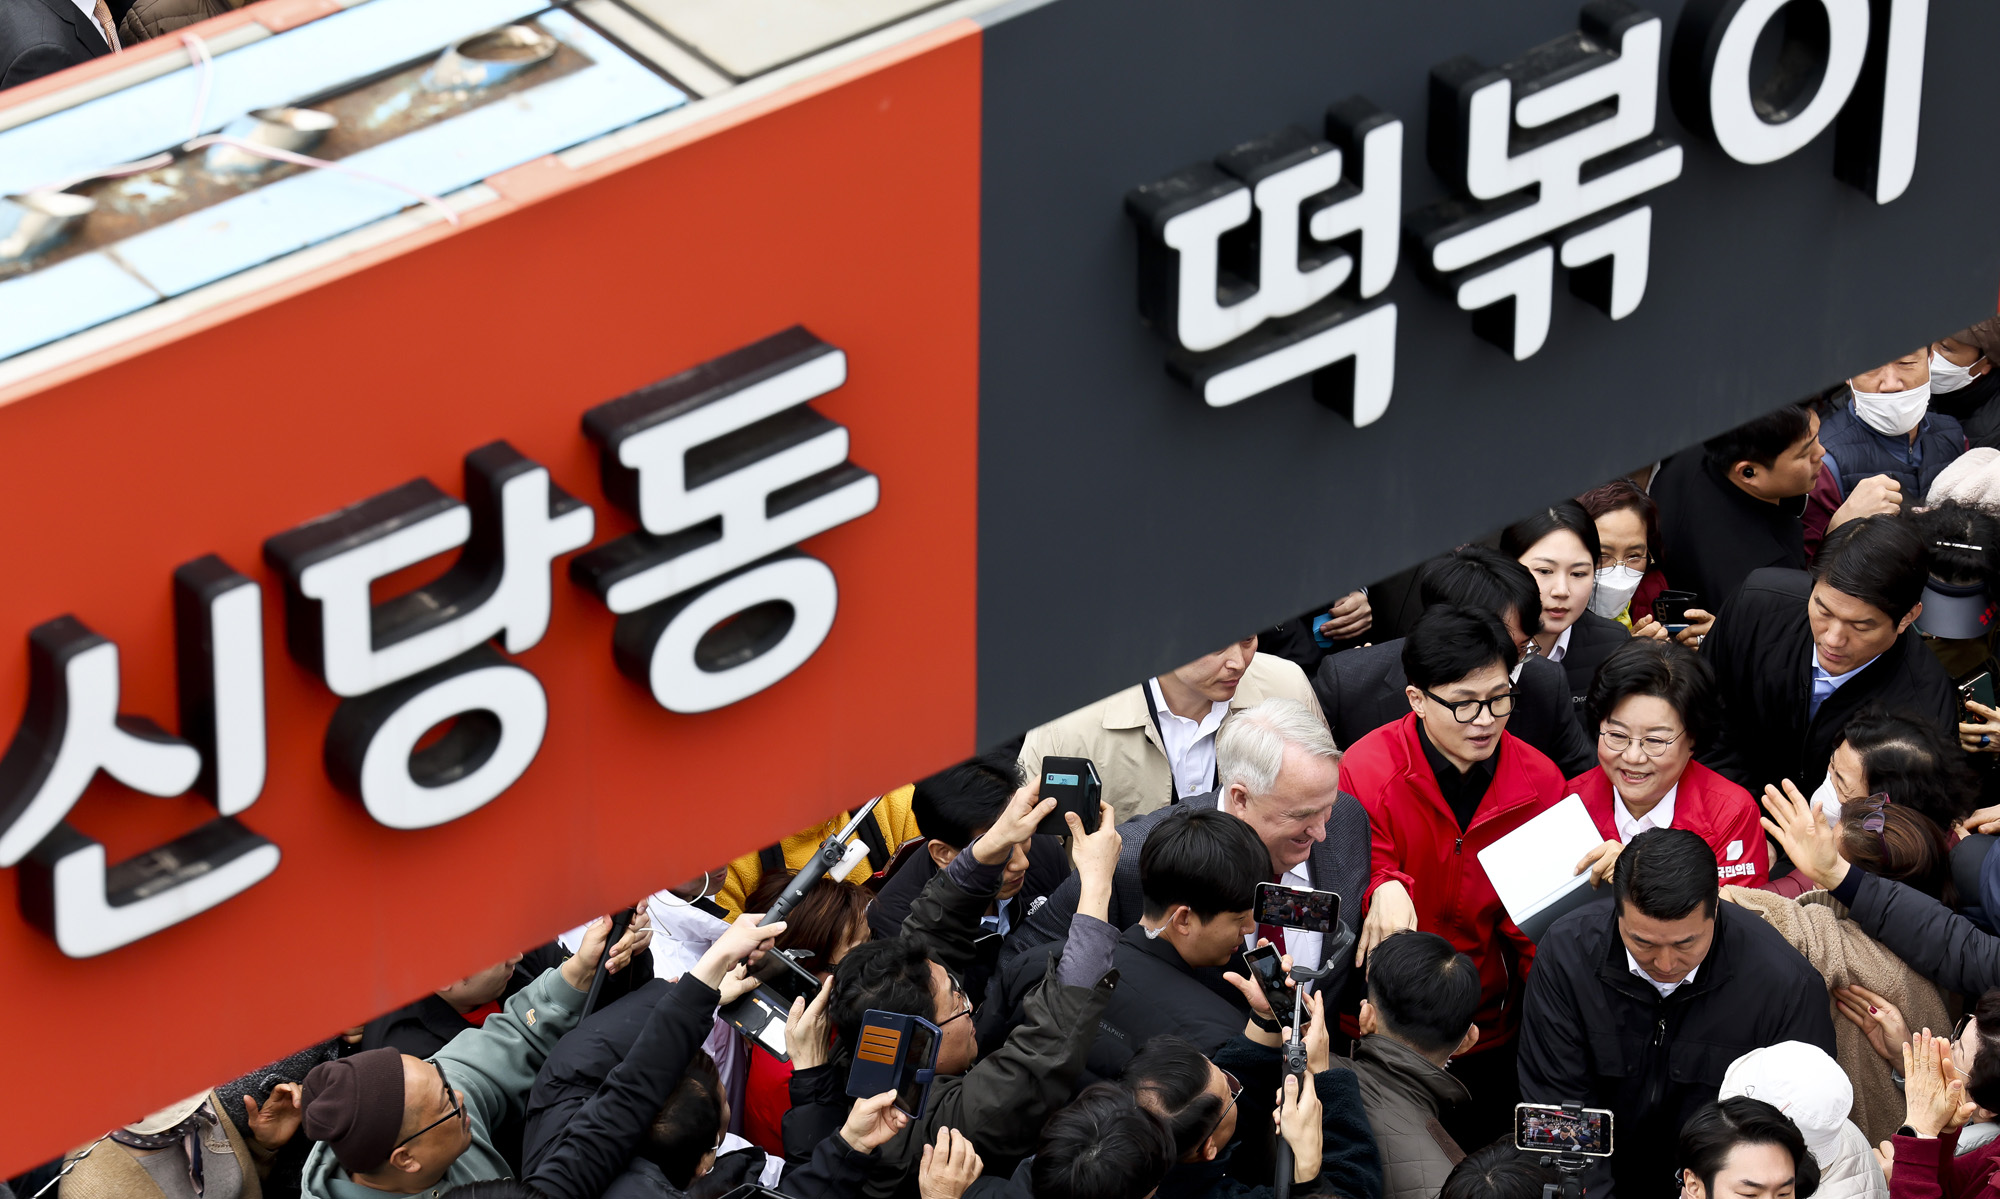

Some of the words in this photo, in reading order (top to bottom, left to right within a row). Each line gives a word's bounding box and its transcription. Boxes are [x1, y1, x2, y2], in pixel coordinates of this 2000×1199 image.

[0, 347, 880, 960] 신당동
[1163, 0, 1930, 429] 떡볶이
[1717, 862, 1756, 878] 국민의힘
